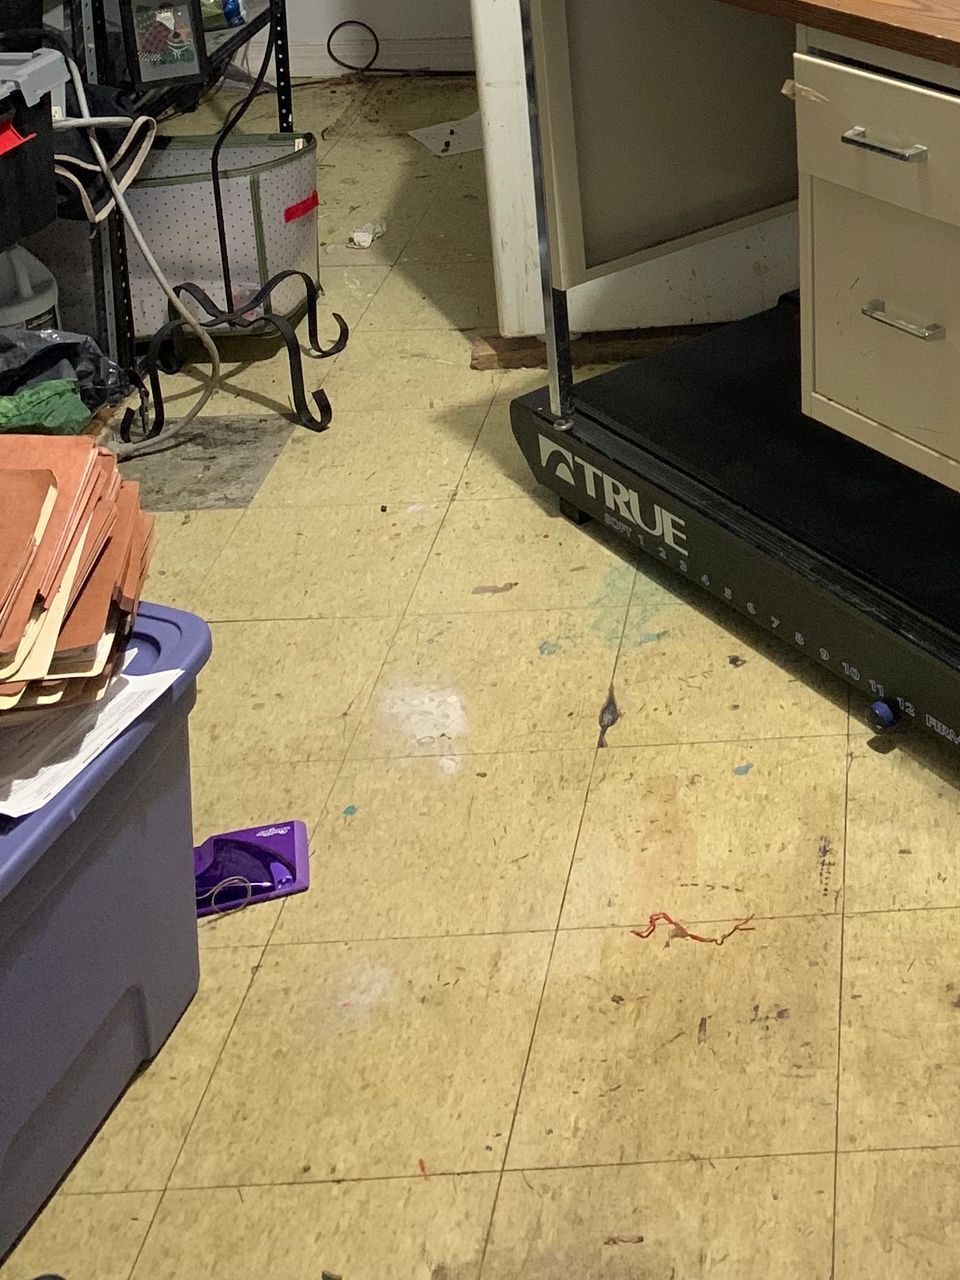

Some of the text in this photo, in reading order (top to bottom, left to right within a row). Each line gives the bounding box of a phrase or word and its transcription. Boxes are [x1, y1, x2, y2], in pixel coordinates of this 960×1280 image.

[574, 455, 689, 557] TRUE
[604, 513, 632, 537] SOFT
[638, 534, 645, 545] 1
[659, 546, 667, 560] 2
[679, 560, 688, 572] 3
[701, 574, 710, 586] 4
[746, 602, 756, 615] 6
[771, 616, 780, 628] 7
[795, 631, 805, 645] 8
[820, 647, 830, 661] 9
[842, 662, 860, 680] 10
[869, 679, 884, 697] 11
[897, 697, 915, 717] 12
